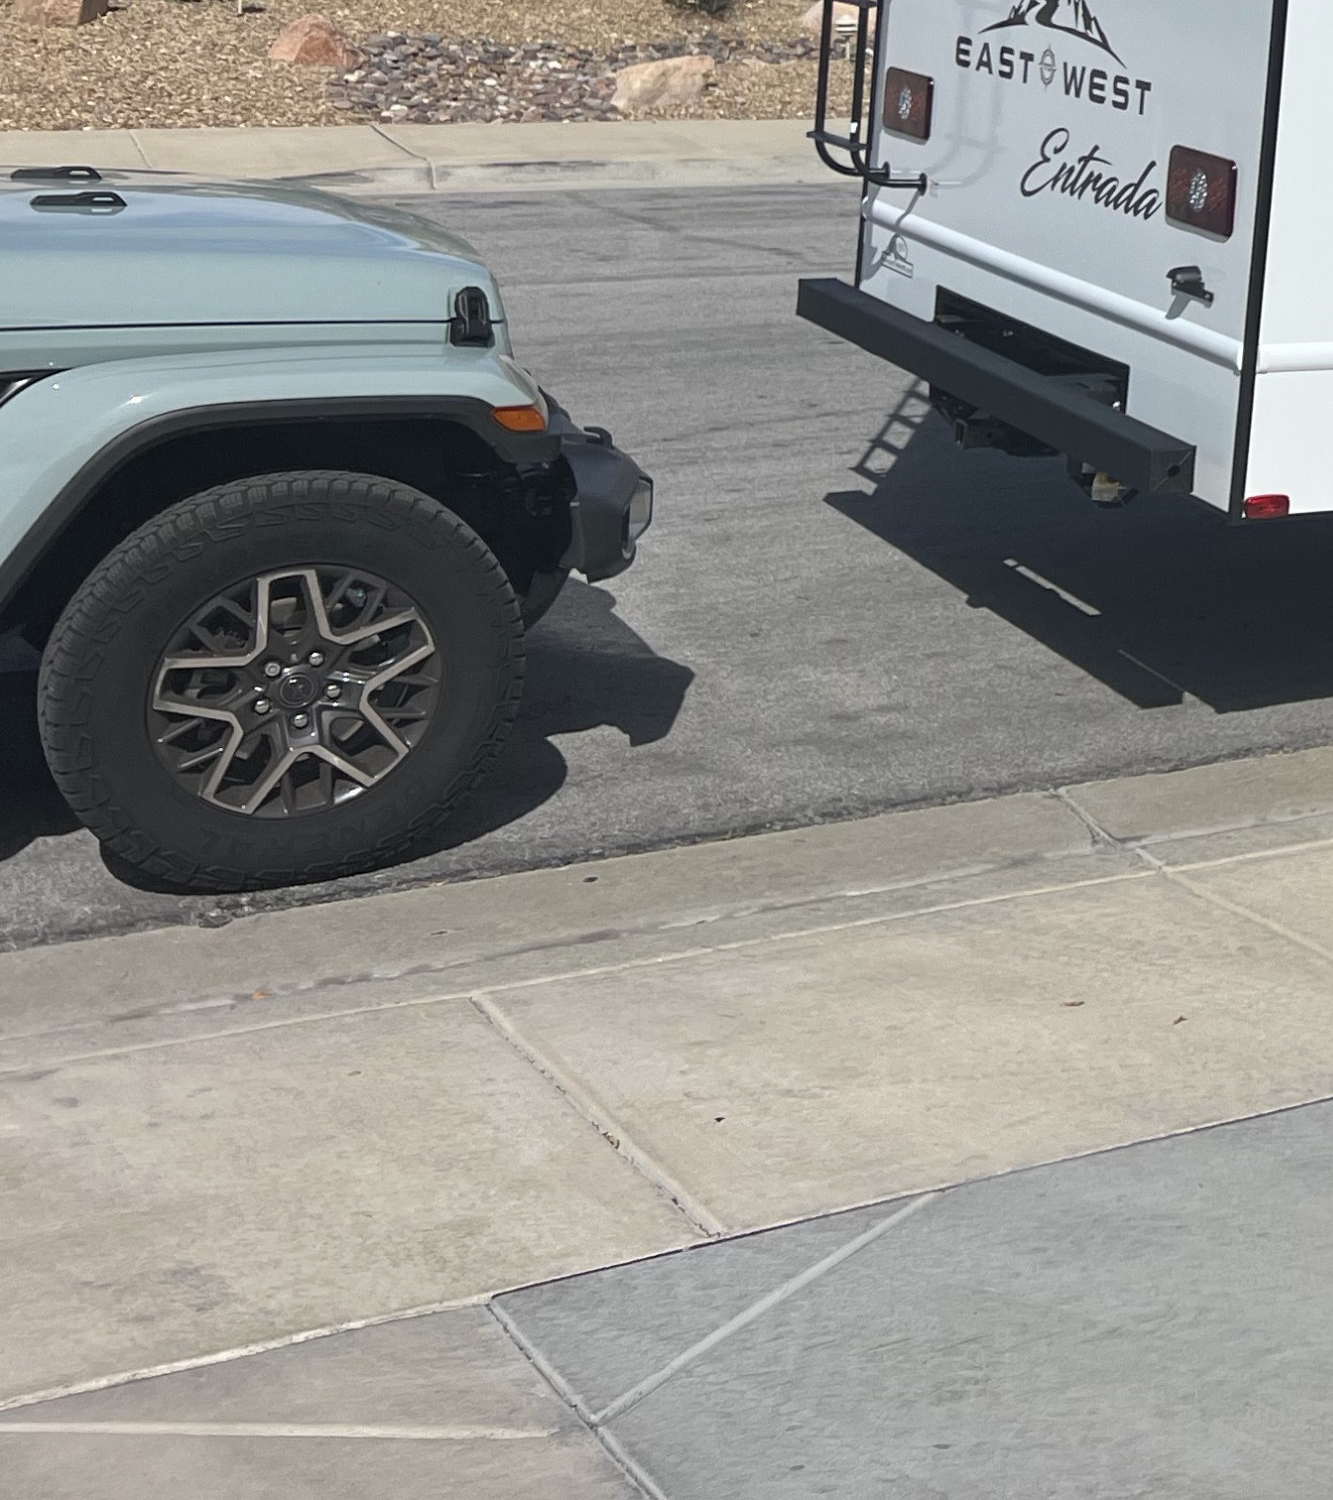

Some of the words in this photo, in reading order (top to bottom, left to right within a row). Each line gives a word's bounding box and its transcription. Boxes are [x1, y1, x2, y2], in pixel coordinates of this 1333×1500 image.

[955, 36, 1034, 84] EAST
[1063, 61, 1152, 115] WEST
[1020, 127, 1162, 220] Entrada
